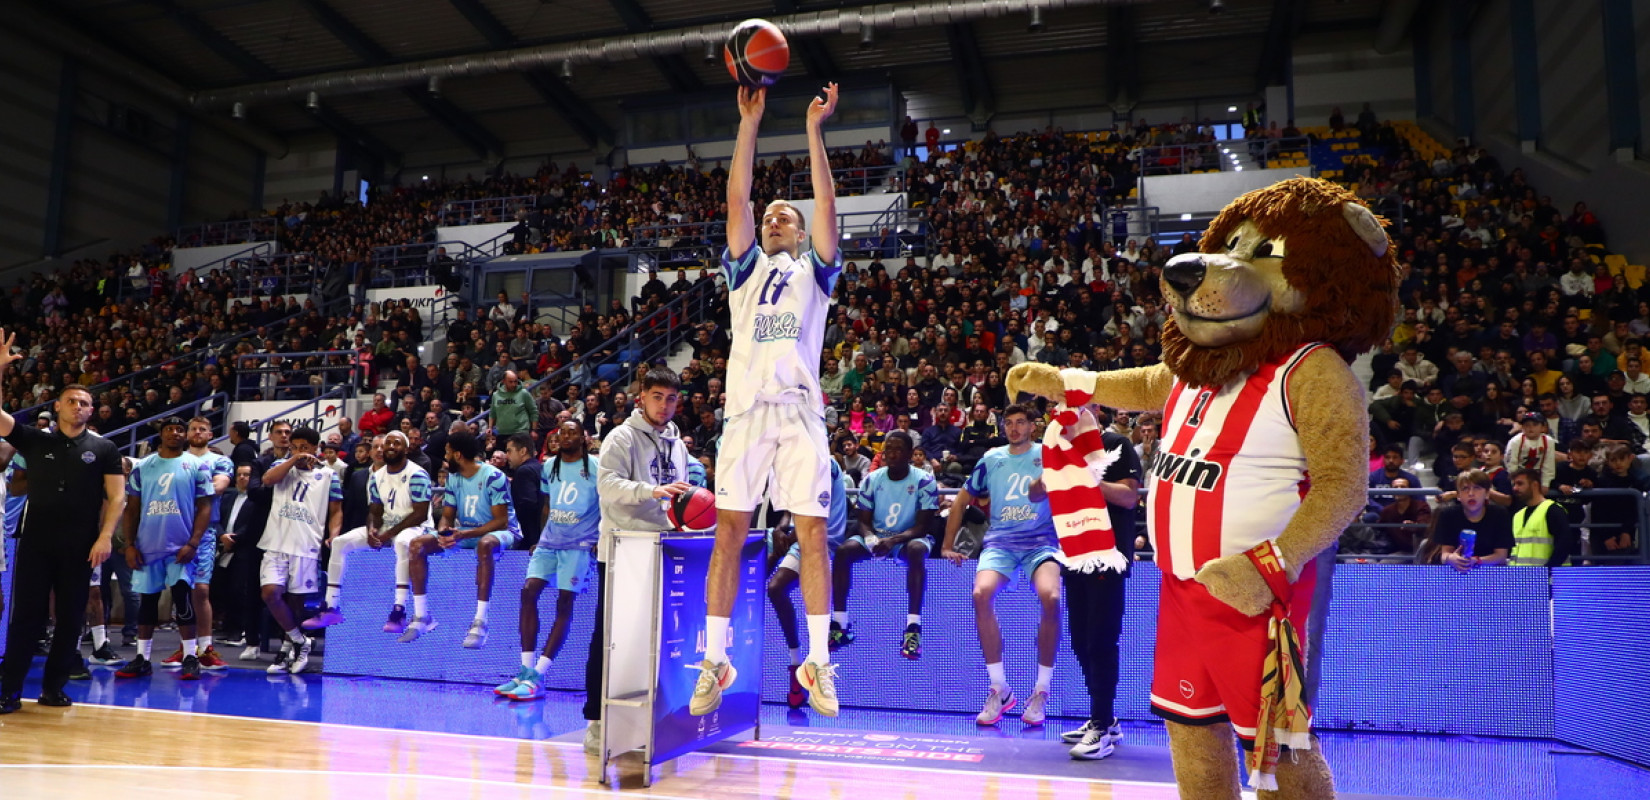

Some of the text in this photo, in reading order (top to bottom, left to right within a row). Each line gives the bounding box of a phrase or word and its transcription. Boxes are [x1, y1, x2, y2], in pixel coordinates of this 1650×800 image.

[758, 268, 794, 305] 17
[1186, 391, 1213, 428] 1
[158, 473, 176, 495] 9
[292, 481, 310, 502] 11
[555, 480, 579, 506] 16
[1005, 473, 1034, 501] 20
[388, 488, 397, 510] 4
[885, 503, 901, 528] 8
[760, 736, 984, 753] JOIN US ON THE
[904, 737, 970, 745] VISION
[893, 750, 976, 761] SIDE
